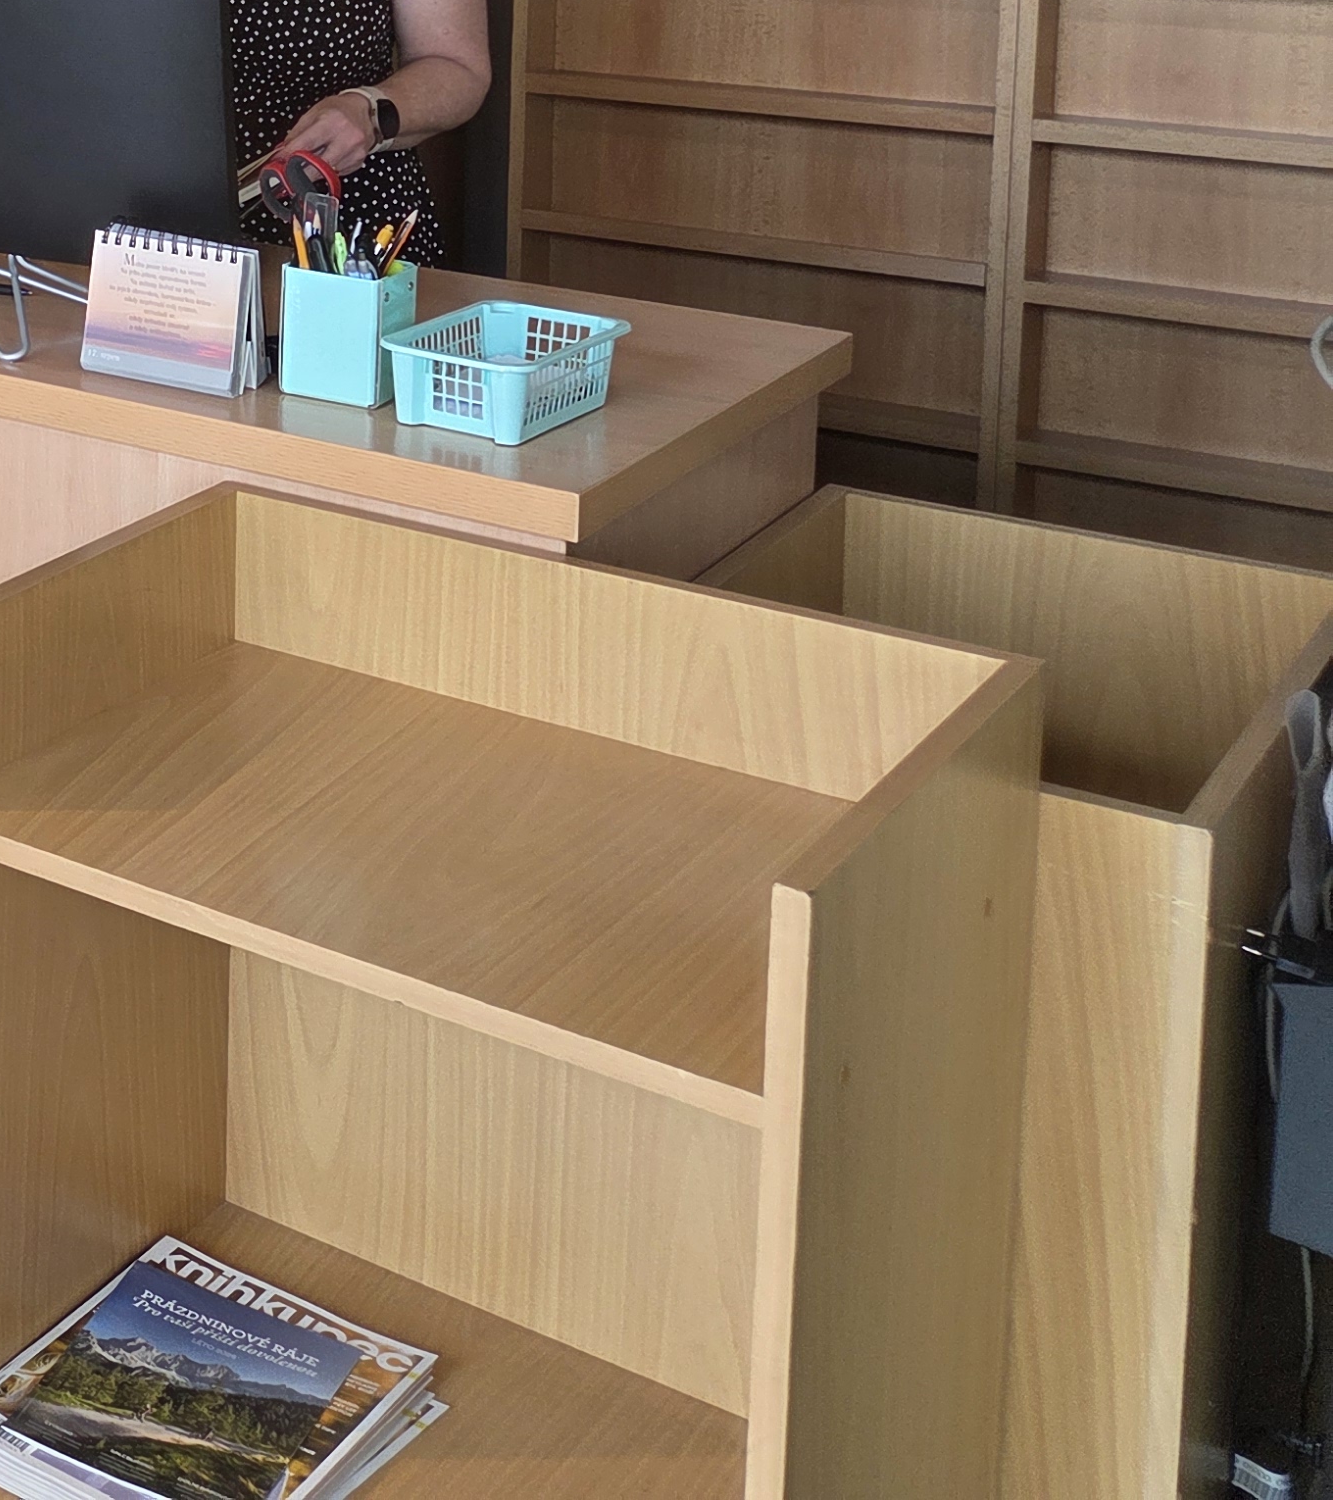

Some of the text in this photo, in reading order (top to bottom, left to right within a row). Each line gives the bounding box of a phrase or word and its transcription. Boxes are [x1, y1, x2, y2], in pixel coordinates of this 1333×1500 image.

[133, 1295, 318, 1378] Pro vaši příští dovolenou
[140, 1289, 320, 1368] PRÁZDNINOVÉ RÁJE
